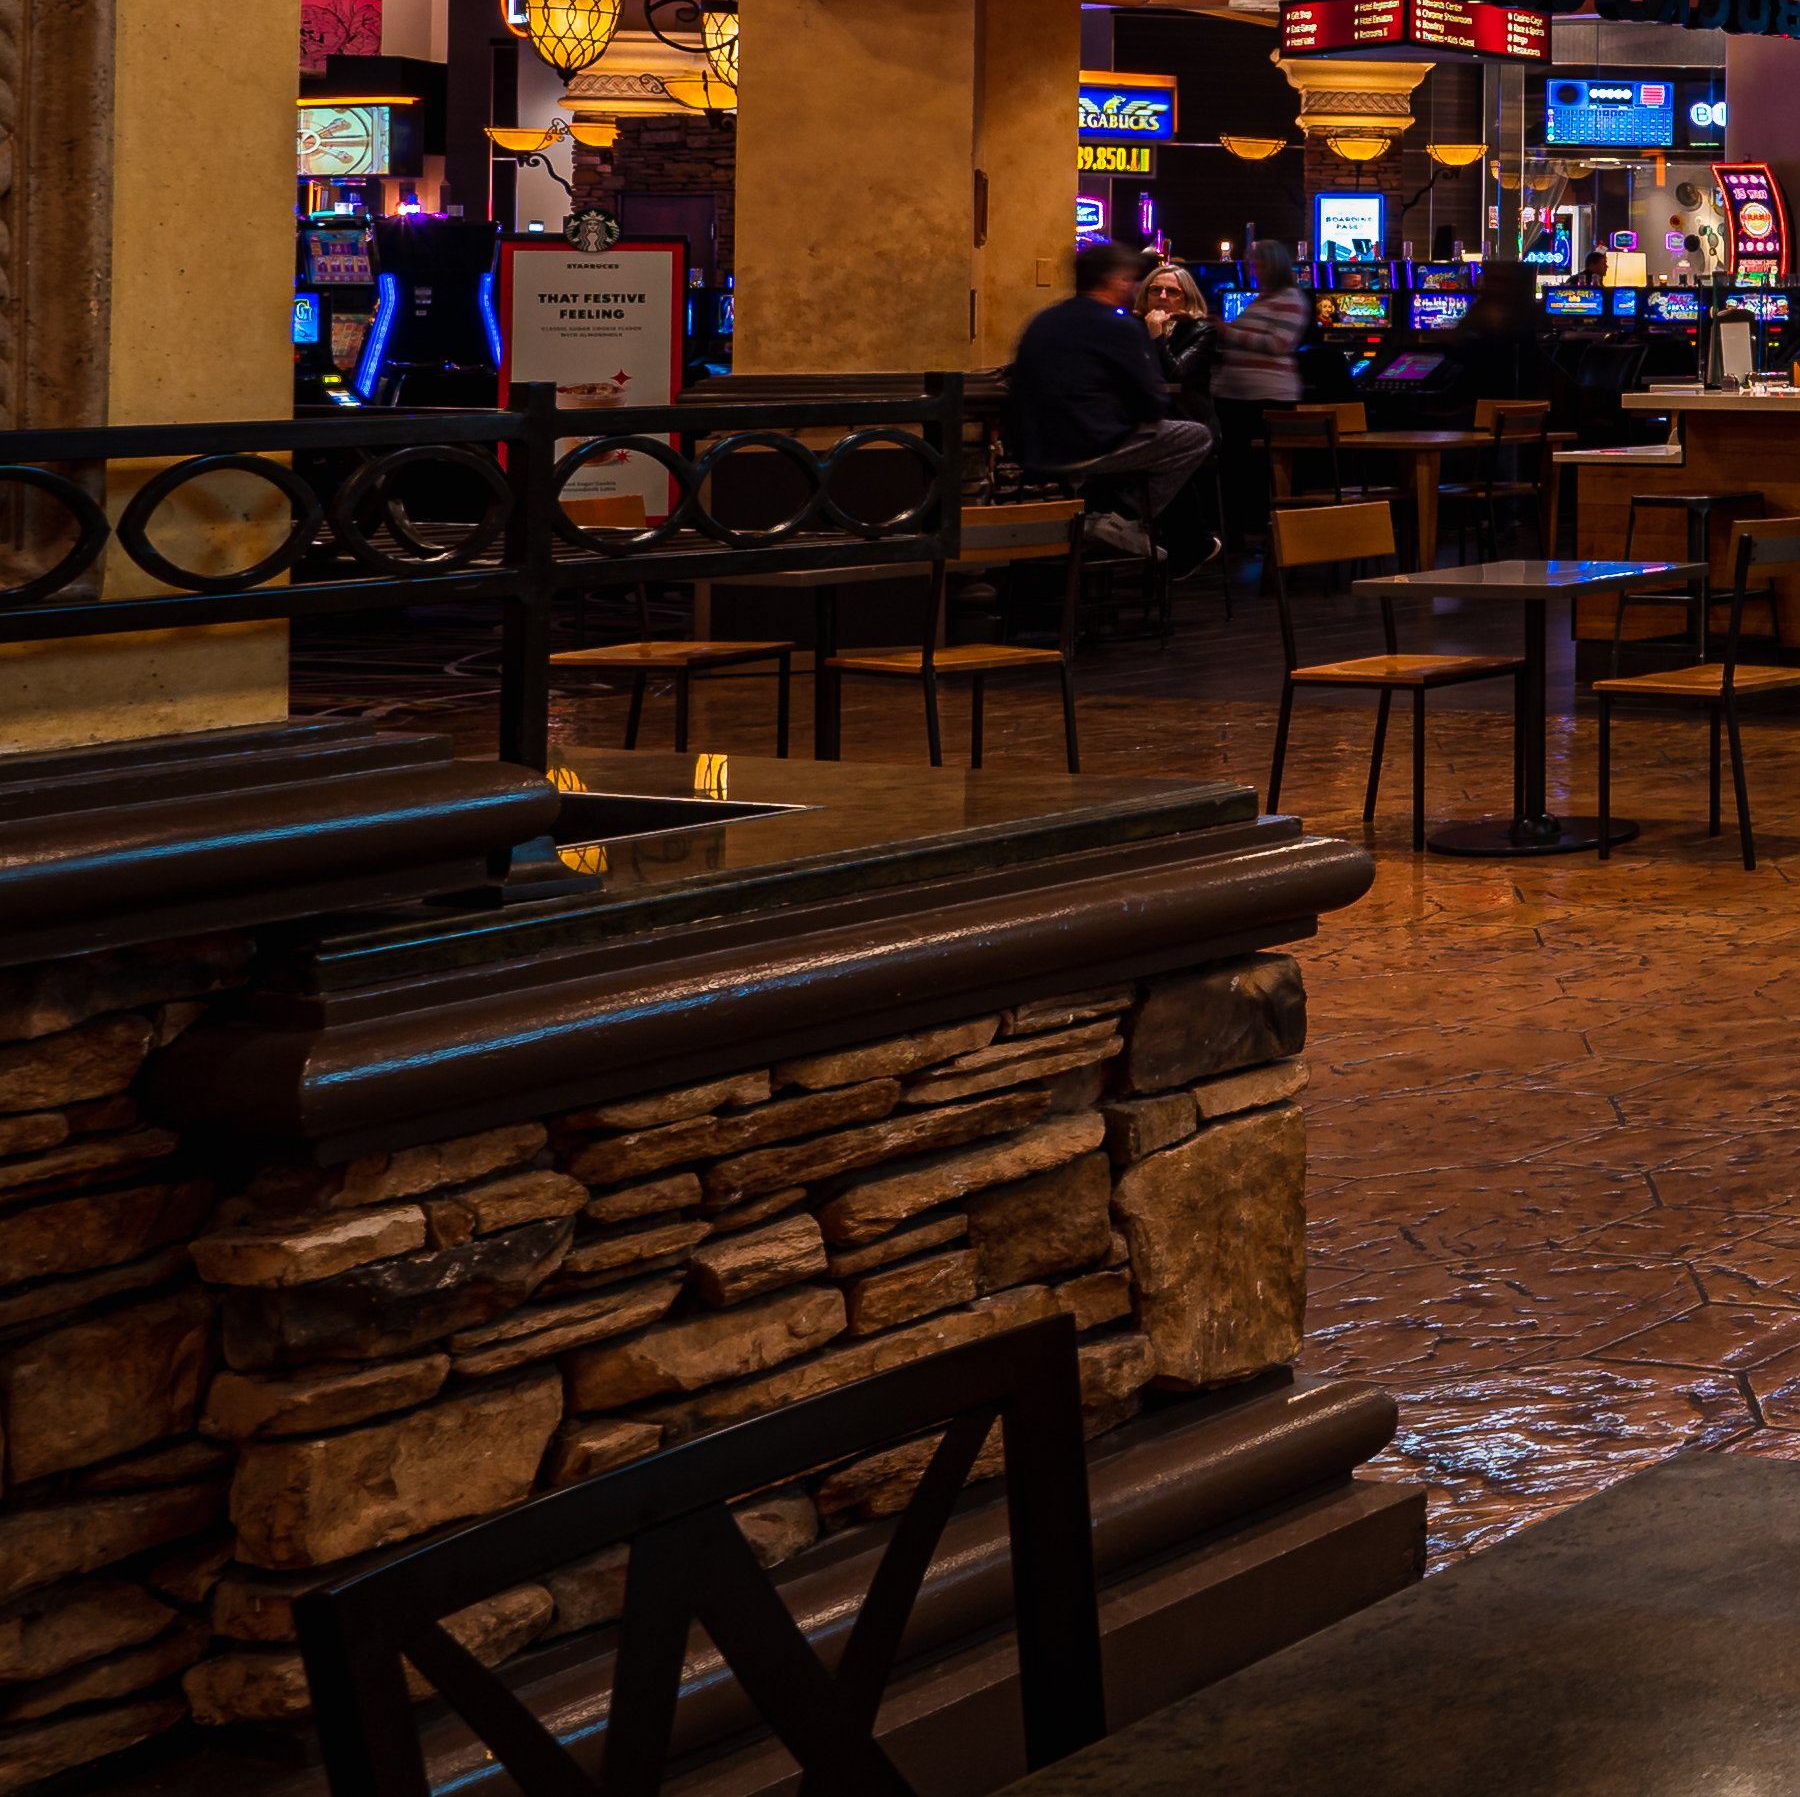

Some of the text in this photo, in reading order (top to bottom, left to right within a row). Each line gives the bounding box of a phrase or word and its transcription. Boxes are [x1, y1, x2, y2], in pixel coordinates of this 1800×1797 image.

[1079, 112, 1160, 131] EGABUCKS
[538, 293, 646, 304] THAT FESTIVE
[559, 309, 625, 319] FEELING
